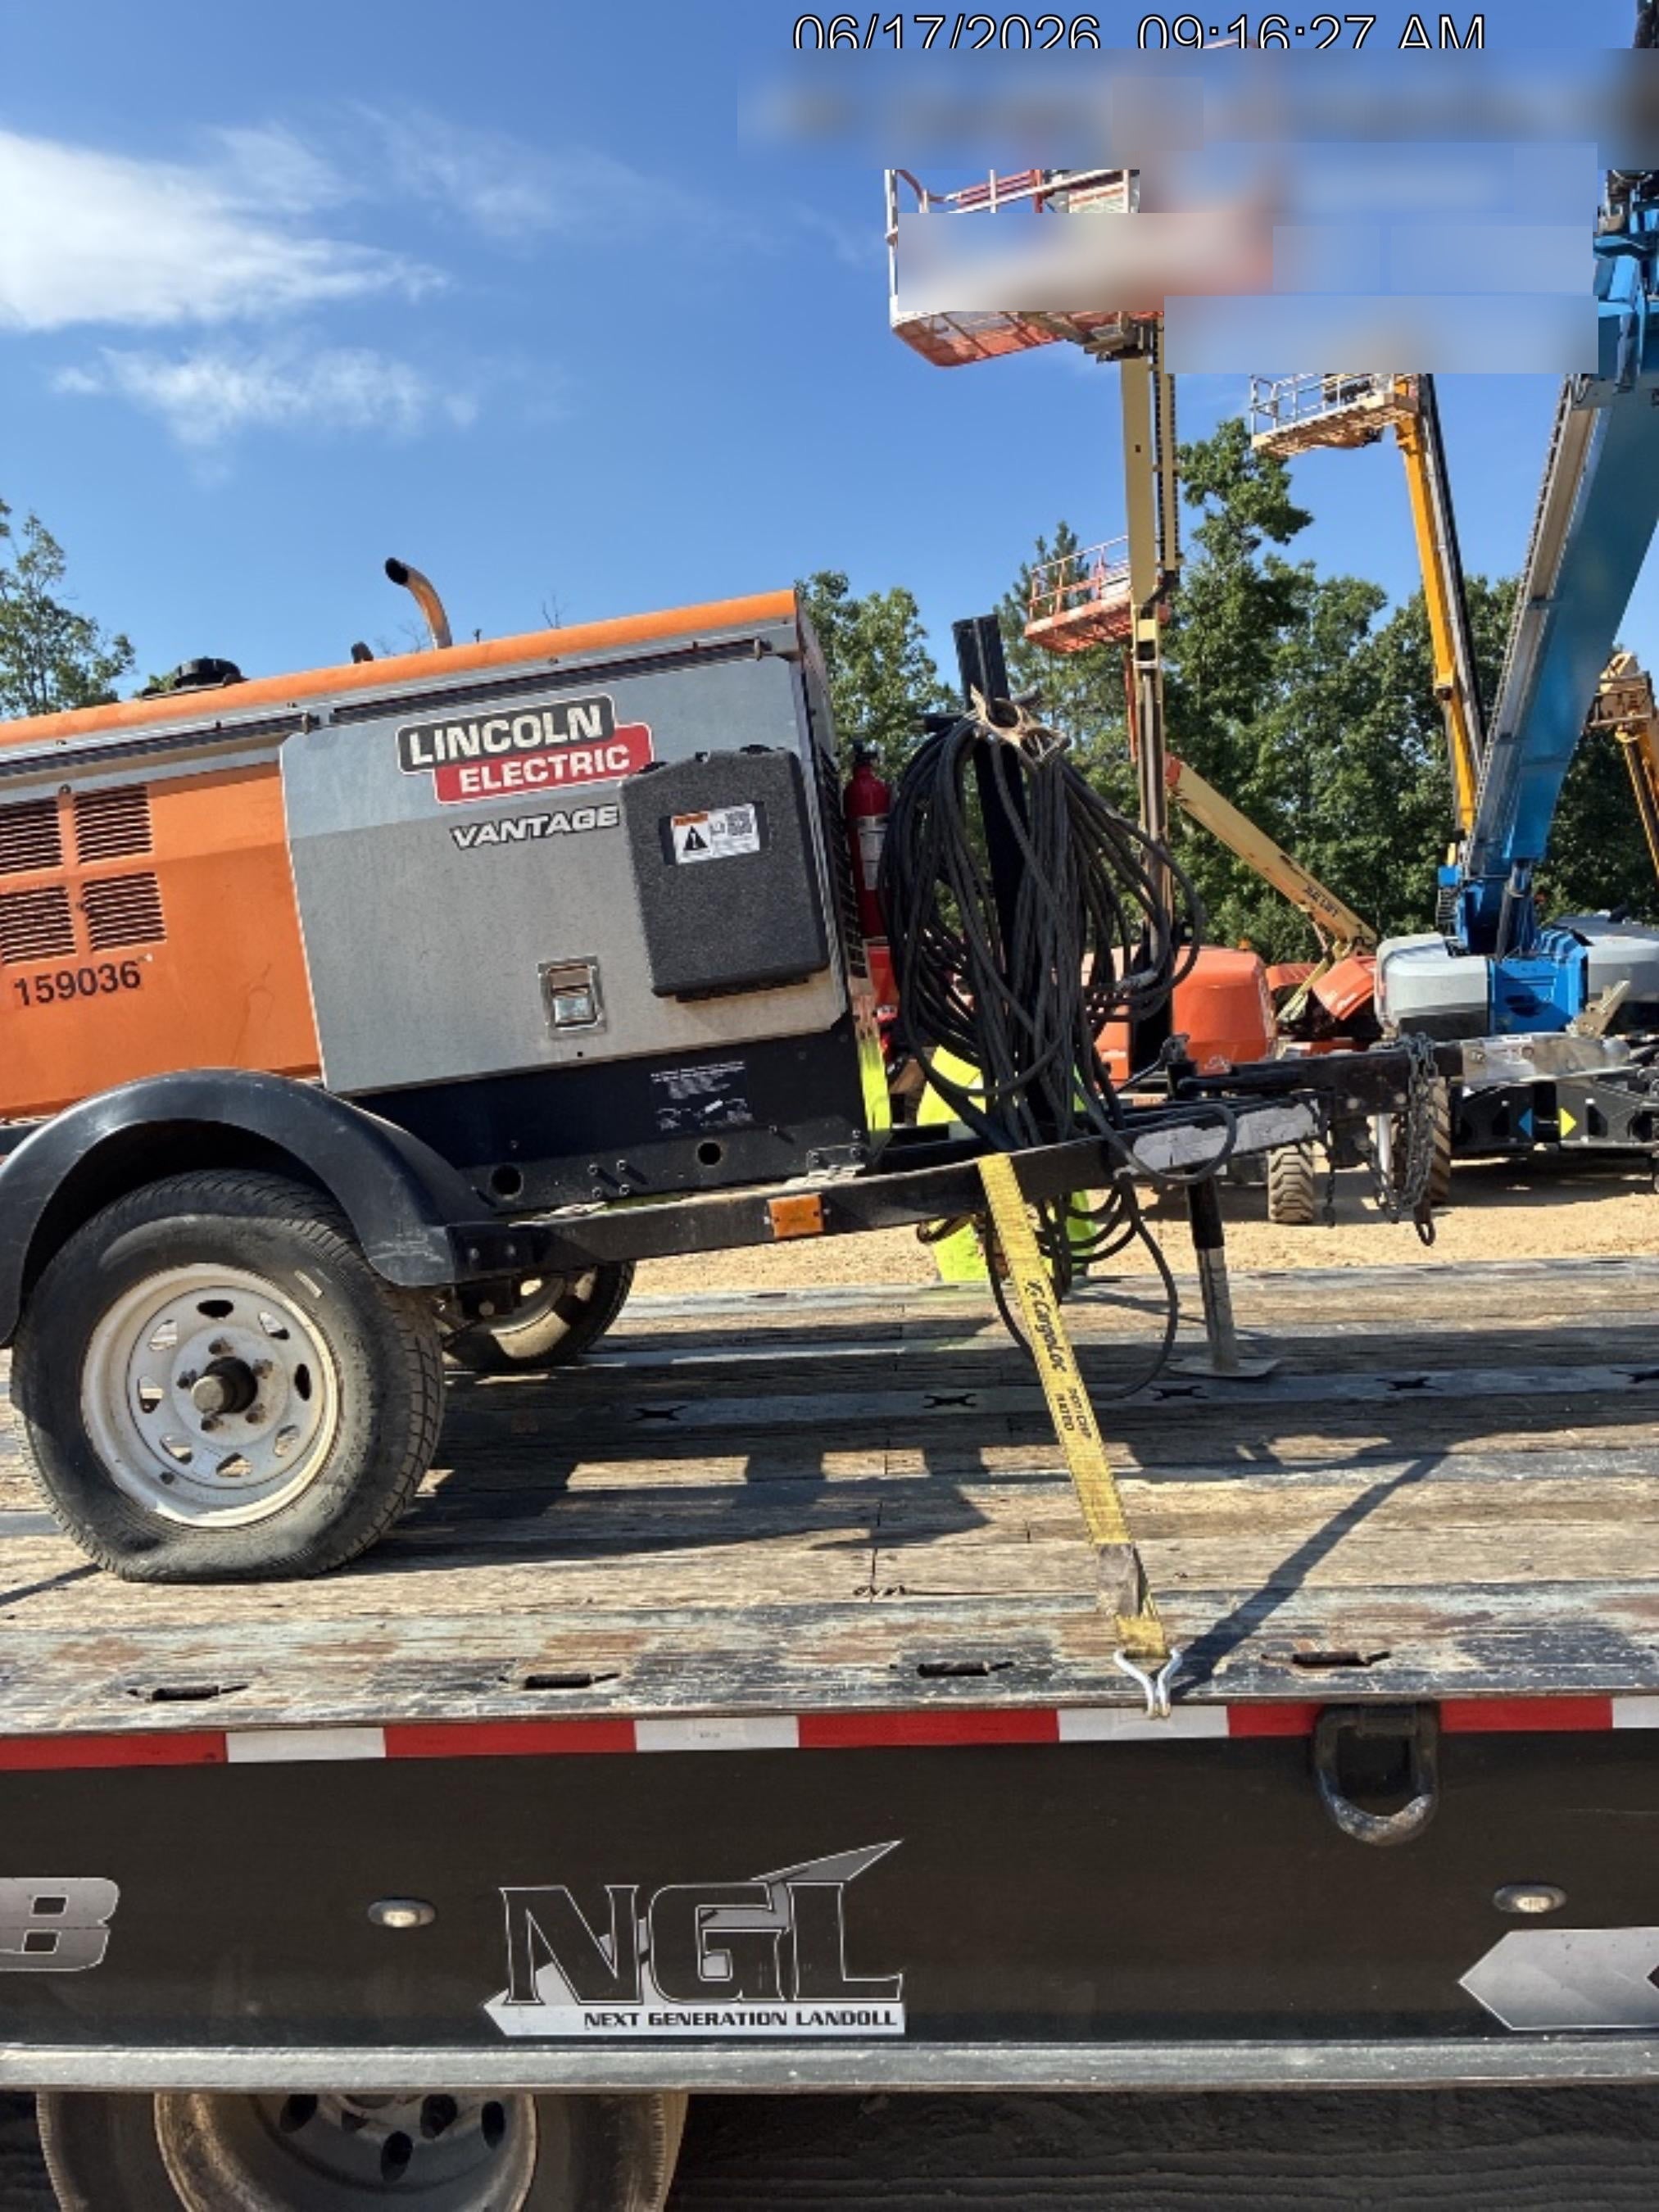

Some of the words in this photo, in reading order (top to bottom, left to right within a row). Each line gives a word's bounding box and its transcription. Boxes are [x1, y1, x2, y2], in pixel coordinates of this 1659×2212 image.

[410, 705, 603, 766] LINCOLN
[460, 745, 631, 795] ELECTRIC
[451, 805, 620, 850] VANTAGE
[13, 959, 142, 1007] 159036
[500, 1882, 903, 2005] NGL
[584, 2011, 642, 2029] NEXT
[648, 2010, 788, 2028] GENERATION
[796, 2009, 898, 2028] LANDOLL
